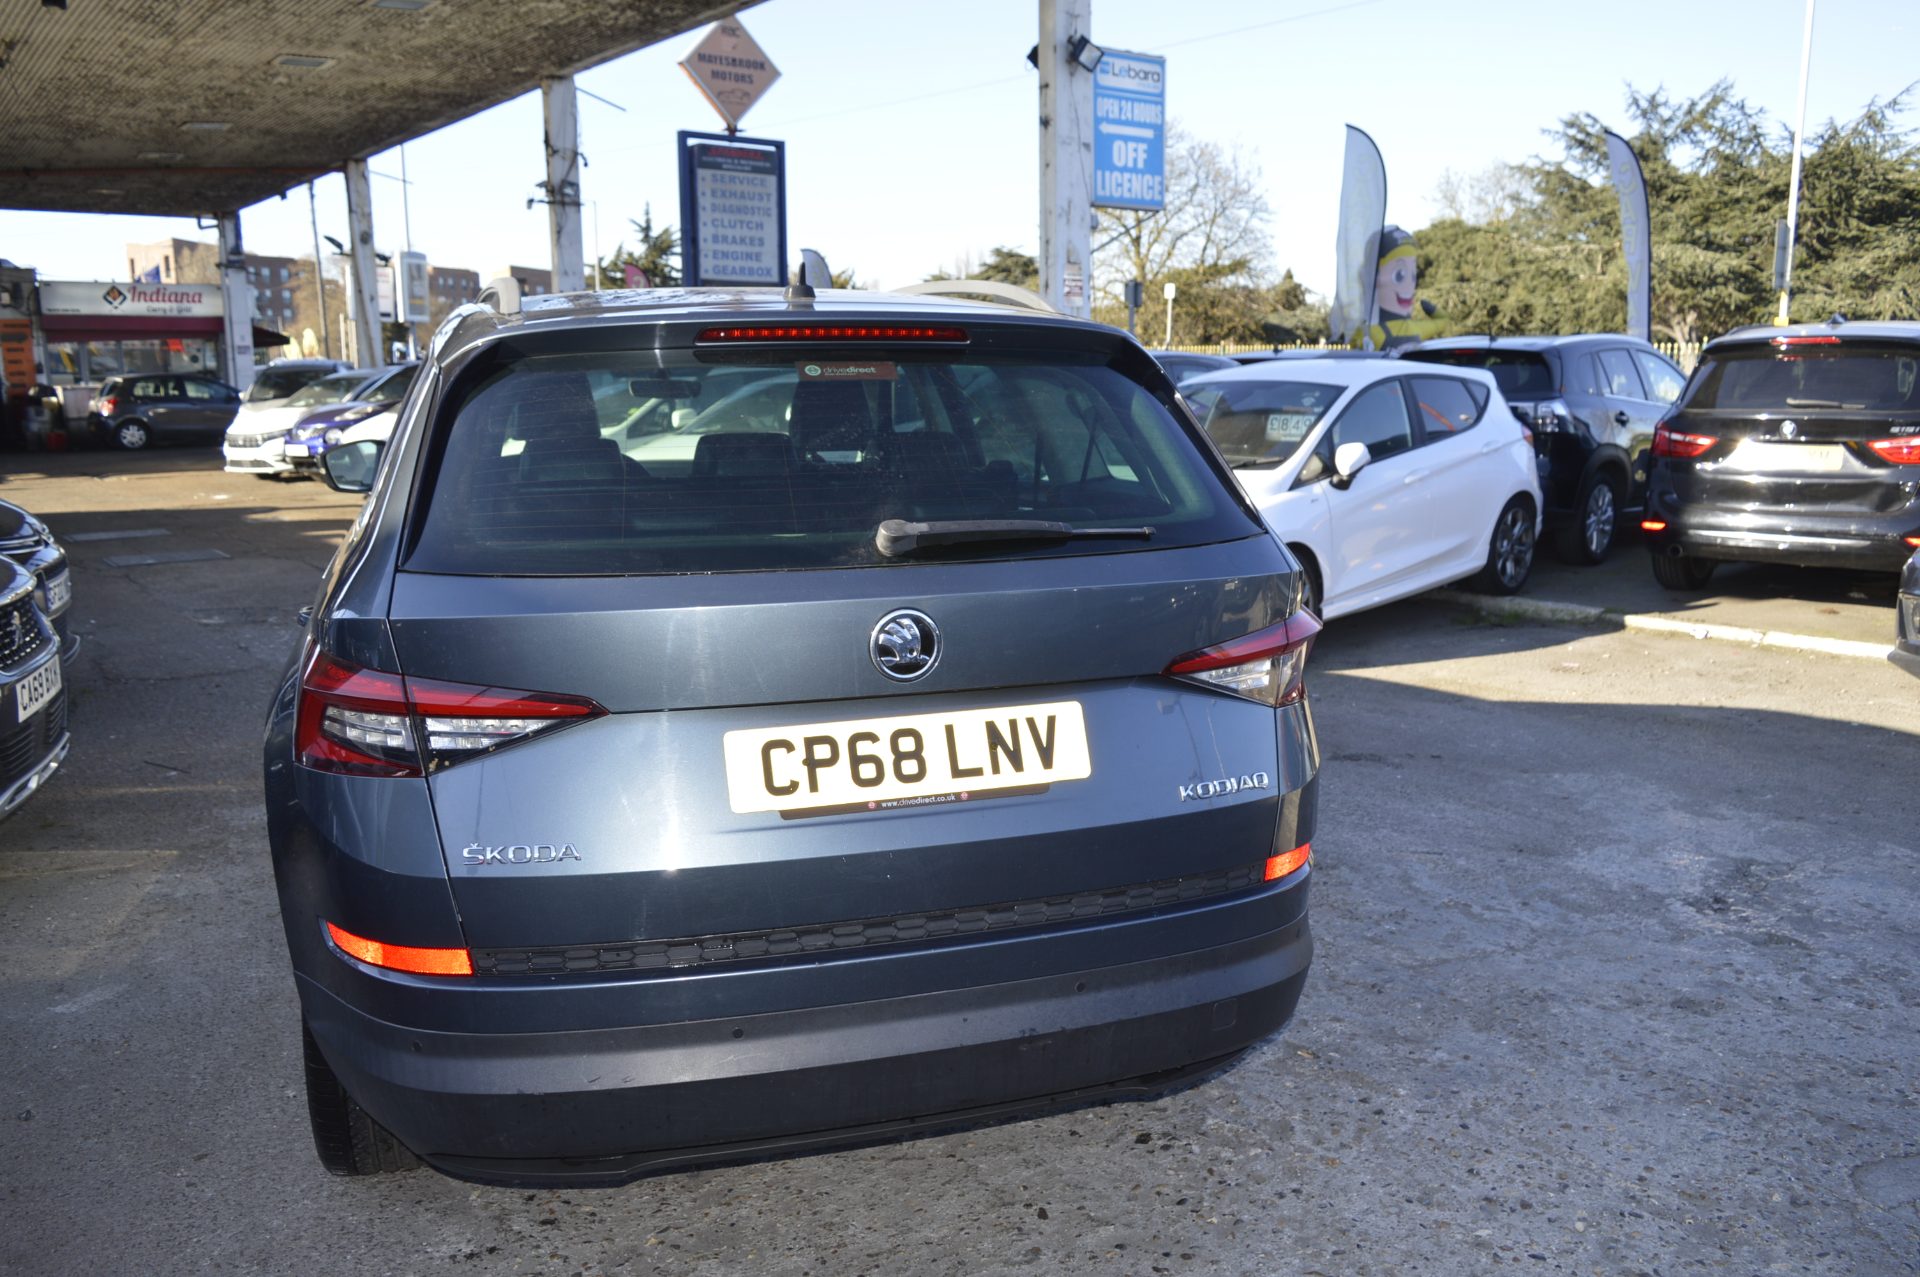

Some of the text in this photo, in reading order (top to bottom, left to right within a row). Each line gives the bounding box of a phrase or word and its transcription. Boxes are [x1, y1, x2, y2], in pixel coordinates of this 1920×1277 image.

[711, 69, 754, 85] MOTORS
[1111, 61, 1161, 83] Lebara
[1096, 96, 1163, 125] OPEN 24 HOURS
[1112, 140, 1148, 169] OFF
[710, 173, 768, 188] SERVICE
[1096, 170, 1163, 201] LICENCE
[710, 188, 773, 203] EXHAUST
[710, 202, 773, 218] DIAGNOSTIC
[711, 218, 764, 232] CLUTCH
[711, 233, 765, 248] BRAKES
[712, 248, 763, 263] ENGINE
[712, 264, 773, 279] GEARBOX
[127, 285, 203, 305] Indiana
[20, 672, 44, 712] CA69
[760, 714, 1057, 797] CP68 LNV
[1179, 771, 1269, 802] KODIAQ
[881, 793, 956, 808] www.drivedirect.co.uk
[462, 842, 582, 866] ŠKODA
